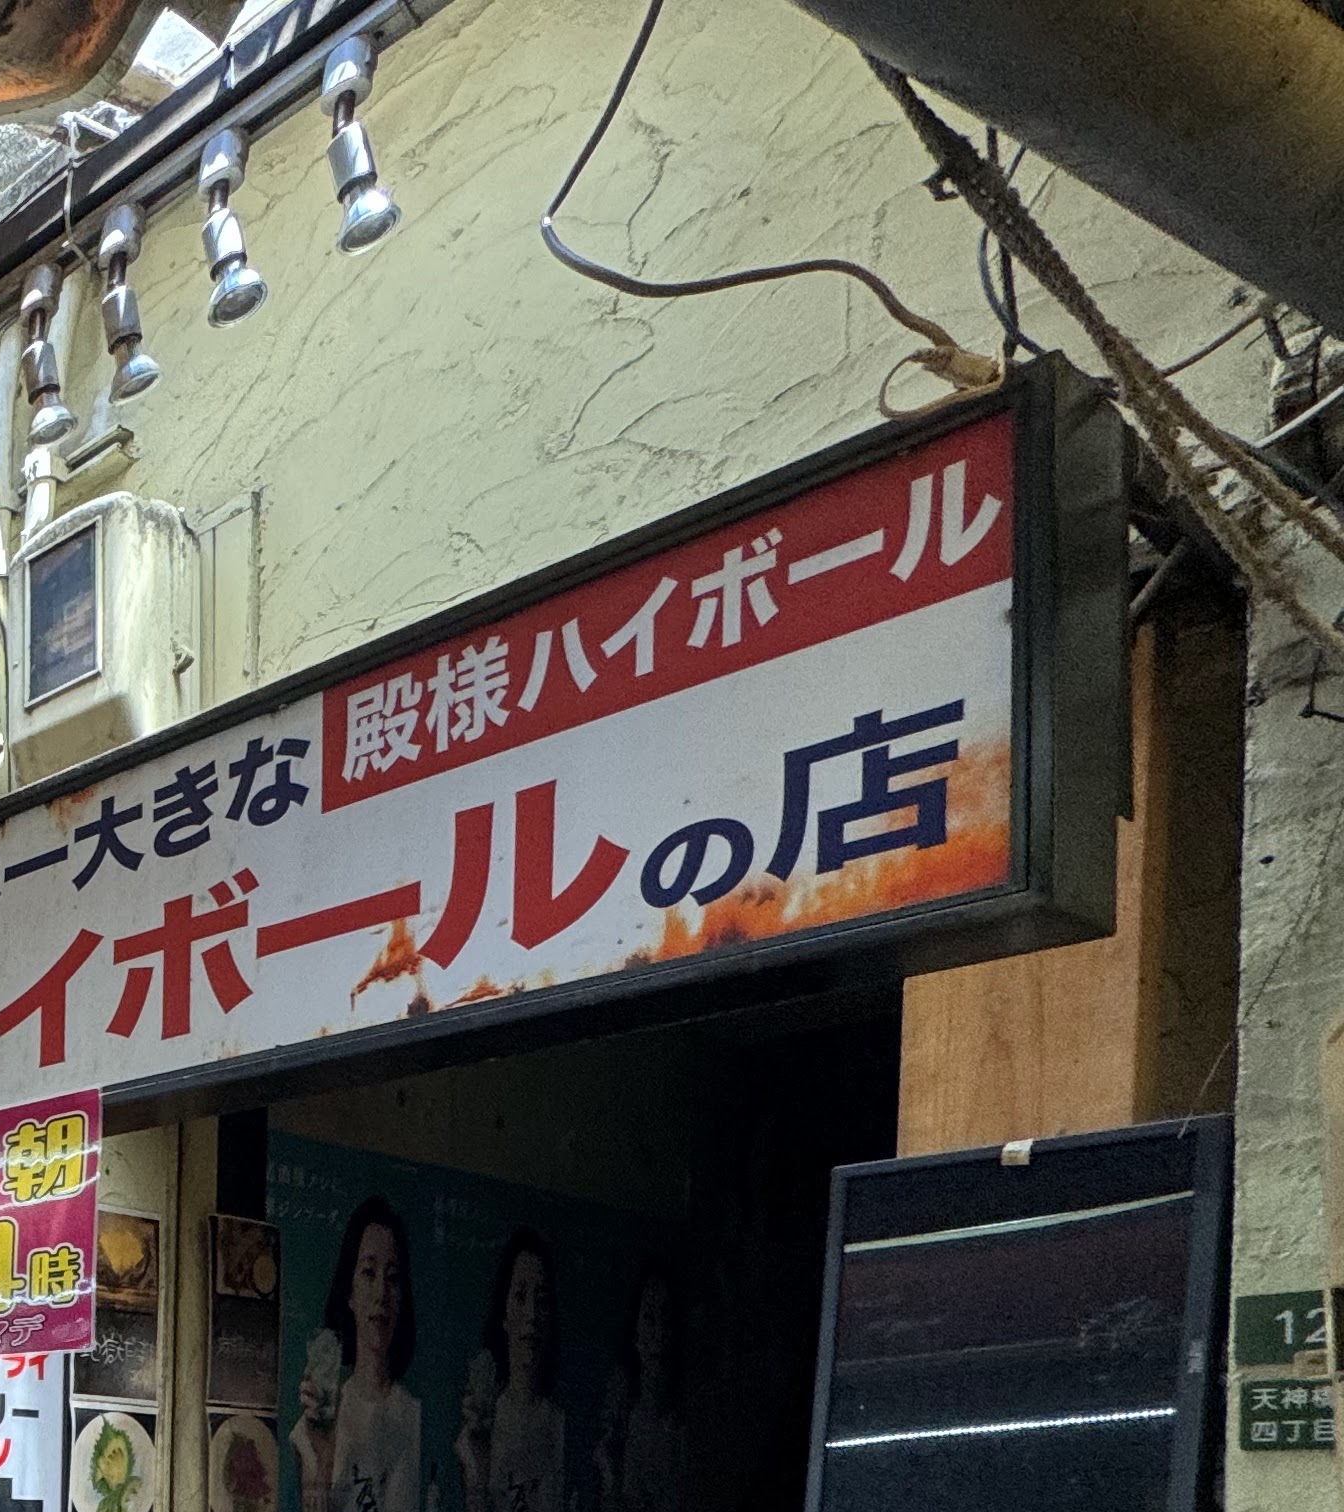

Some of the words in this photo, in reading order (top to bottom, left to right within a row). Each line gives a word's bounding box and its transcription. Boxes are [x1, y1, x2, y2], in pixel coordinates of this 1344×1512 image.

[341, 460, 1005, 780] 殿様ハイボール
[1, 1110, 90, 1207] 朝
